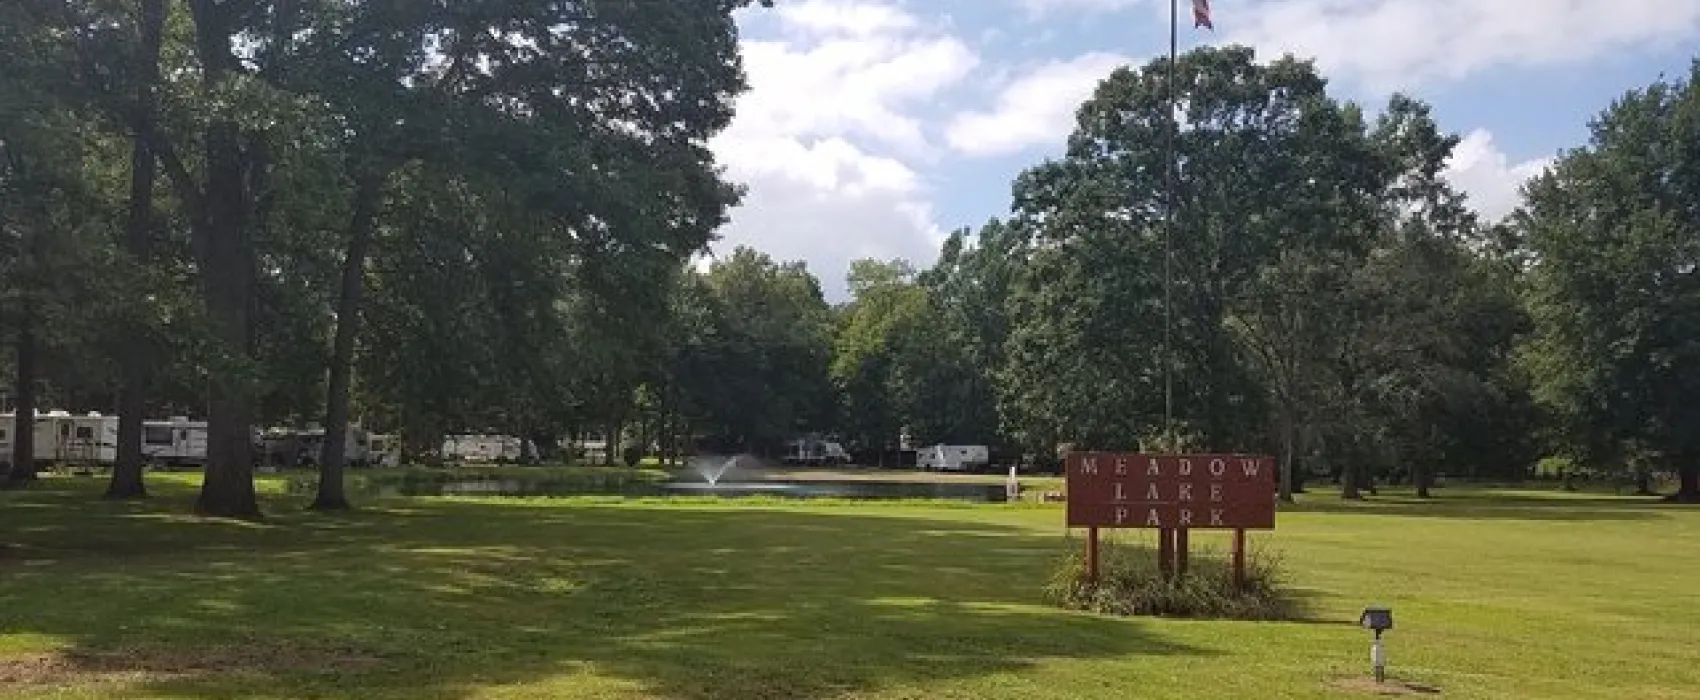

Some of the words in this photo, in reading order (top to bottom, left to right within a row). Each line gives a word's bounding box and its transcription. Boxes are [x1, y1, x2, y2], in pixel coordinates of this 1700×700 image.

[1081, 458, 1260, 476] MEADOW
[1115, 483, 1224, 501] LAKE
[1115, 506, 1224, 526] PARK
